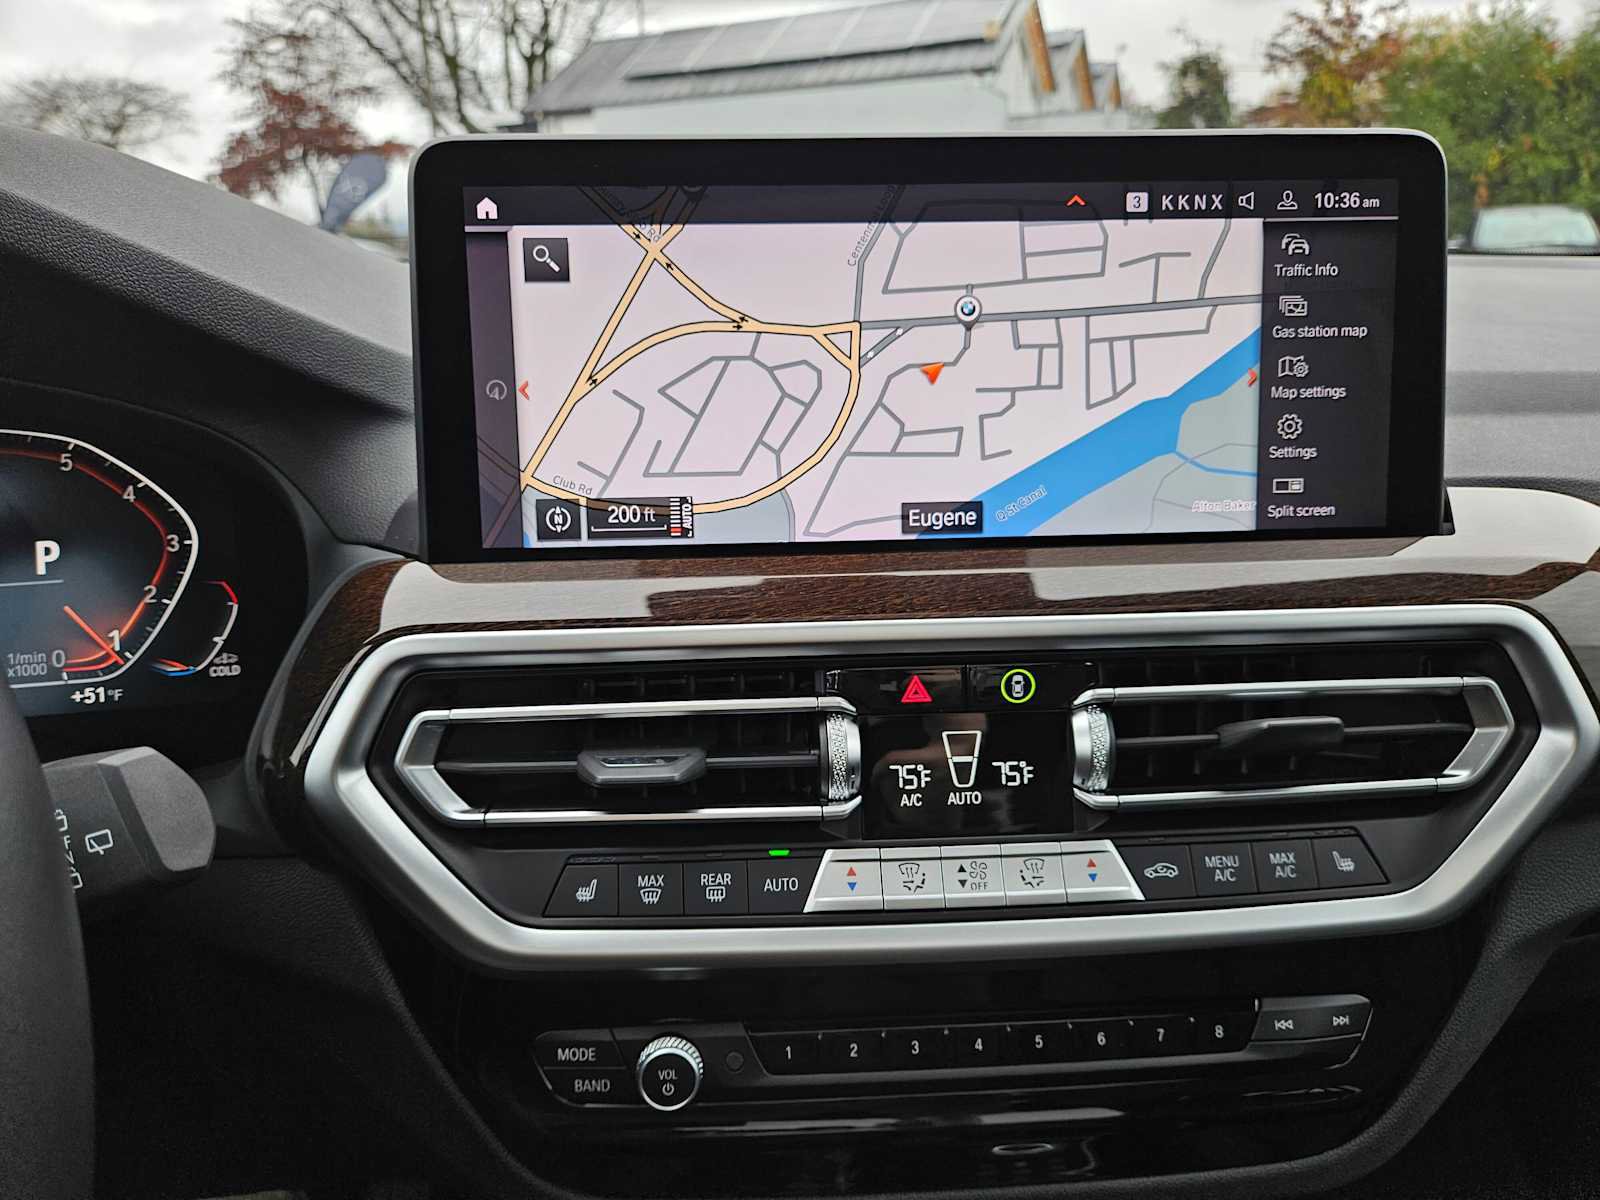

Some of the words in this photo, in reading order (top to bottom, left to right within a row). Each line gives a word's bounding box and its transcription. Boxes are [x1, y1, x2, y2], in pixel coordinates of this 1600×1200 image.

[1132, 196, 1142, 209] 3
[1314, 192, 1361, 209] 10:36
[1362, 197, 1380, 209] am
[1274, 264, 1313, 277] Traffic
[1315, 263, 1339, 276] Info
[1272, 326, 1295, 339] Gas
[1297, 325, 1339, 338] station
[1341, 325, 1368, 340] map
[1271, 387, 1298, 400] Map
[1299, 386, 1347, 399] settings
[1269, 446, 1318, 460] Settings
[60, 453, 73, 472] 5
[552, 475, 576, 491] Club
[577, 483, 593, 496] Rd
[122, 485, 136, 502] 4
[1018, 486, 1047, 507] Canal
[607, 505, 640, 524] 200
[643, 508, 656, 523] ft
[682, 504, 693, 529] AUTO
[1268, 505, 1294, 518] Split
[1296, 504, 1336, 517] screen
[909, 509, 977, 529] Eugene
[166, 534, 180, 552] 3
[34, 540, 61, 575] P
[143, 585, 157, 602] 2
[107, 629, 121, 651] 1
[8, 651, 47, 665] 1/min
[51, 650, 66, 668] 0
[8, 664, 48, 677] x1000
[208, 664, 241, 677] COLD
[900, 794, 923, 807] A/C
[947, 792, 982, 805] AUTO
[1205, 855, 1239, 868] MENU
[1269, 852, 1295, 865] MAX
[1214, 869, 1236, 882] A/C
[1275, 865, 1296, 878] A/C
[637, 875, 664, 887] MAX
[701, 873, 731, 886] REAR
[764, 877, 799, 892] AUTO
[970, 881, 988, 891] OFF
[1097, 1031, 1106, 1046] 6
[1156, 1028, 1165, 1042] 7
[1215, 1024, 1224, 1039] 8
[911, 1040, 920, 1055] 3
[974, 1037, 984, 1052] 4
[1035, 1034, 1043, 1049] 5
[557, 1047, 596, 1061] MODE
[785, 1046, 792, 1060] 1
[850, 1043, 858, 1058] 2
[658, 1069, 678, 1081] VOL
[574, 1079, 611, 1093] BAND
